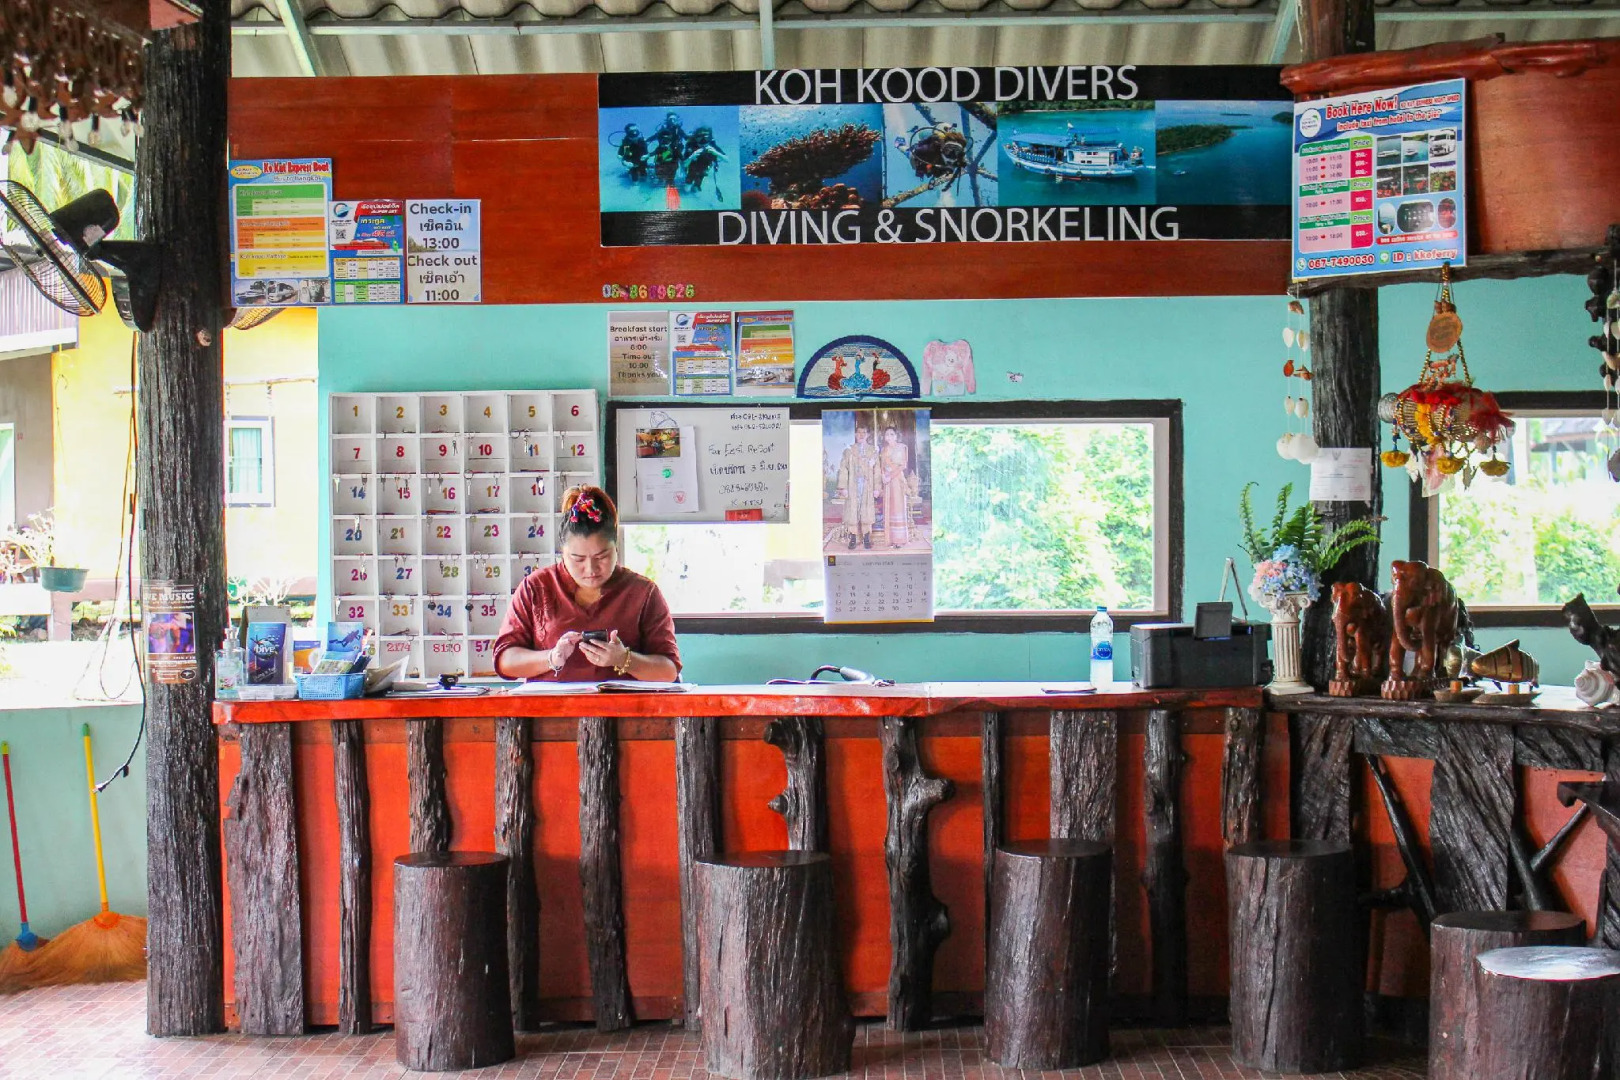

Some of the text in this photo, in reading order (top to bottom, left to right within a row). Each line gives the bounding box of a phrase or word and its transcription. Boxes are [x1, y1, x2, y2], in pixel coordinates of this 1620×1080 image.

[755, 65, 1139, 105] KOH KOOD DIVERS
[1326, 95, 1398, 119] Book Here Now!
[1406, 113, 1414, 122] to
[1415, 111, 1426, 120] the
[1427, 109, 1442, 121] pier
[287, 161, 312, 174] Express
[313, 161, 329, 172] Boat
[410, 203, 472, 215] Check-in
[718, 206, 1180, 246] DIVING & SNORKELING
[423, 237, 460, 249] 13:00
[407, 255, 478, 267] Check out
[1393, 251, 1404, 262] ID
[425, 289, 460, 301] 11:00
[353, 405, 359, 417] 1
[396, 406, 404, 418] 2
[439, 405, 447, 416] 3
[483, 406, 492, 418] 4
[528, 406, 536, 417] 5
[571, 405, 579, 417] 6
[353, 448, 361, 459] 7
[396, 446, 405, 457] 8
[439, 444, 447, 457] 9
[478, 444, 493, 456] 10
[528, 444, 539, 457] 11
[570, 444, 585, 456] 12
[352, 486, 366, 499] 14
[397, 487, 411, 499] 15
[442, 487, 456, 500] 16
[486, 485, 500, 497] 17
[345, 529, 362, 541] 20
[390, 527, 405, 540] 21
[436, 525, 451, 539] 22
[484, 524, 500, 538] 23
[528, 525, 545, 538] 24
[396, 567, 413, 580] 27
[443, 566, 459, 578] 28
[485, 566, 500, 579] 29
[160, 593, 195, 601] MUSIC
[349, 606, 365, 619] 32
[392, 604, 409, 616] 33
[437, 604, 452, 618] 34
[481, 604, 497, 617] 35
[254, 645, 276, 653] DIVE
[387, 642, 411, 652] 2174
